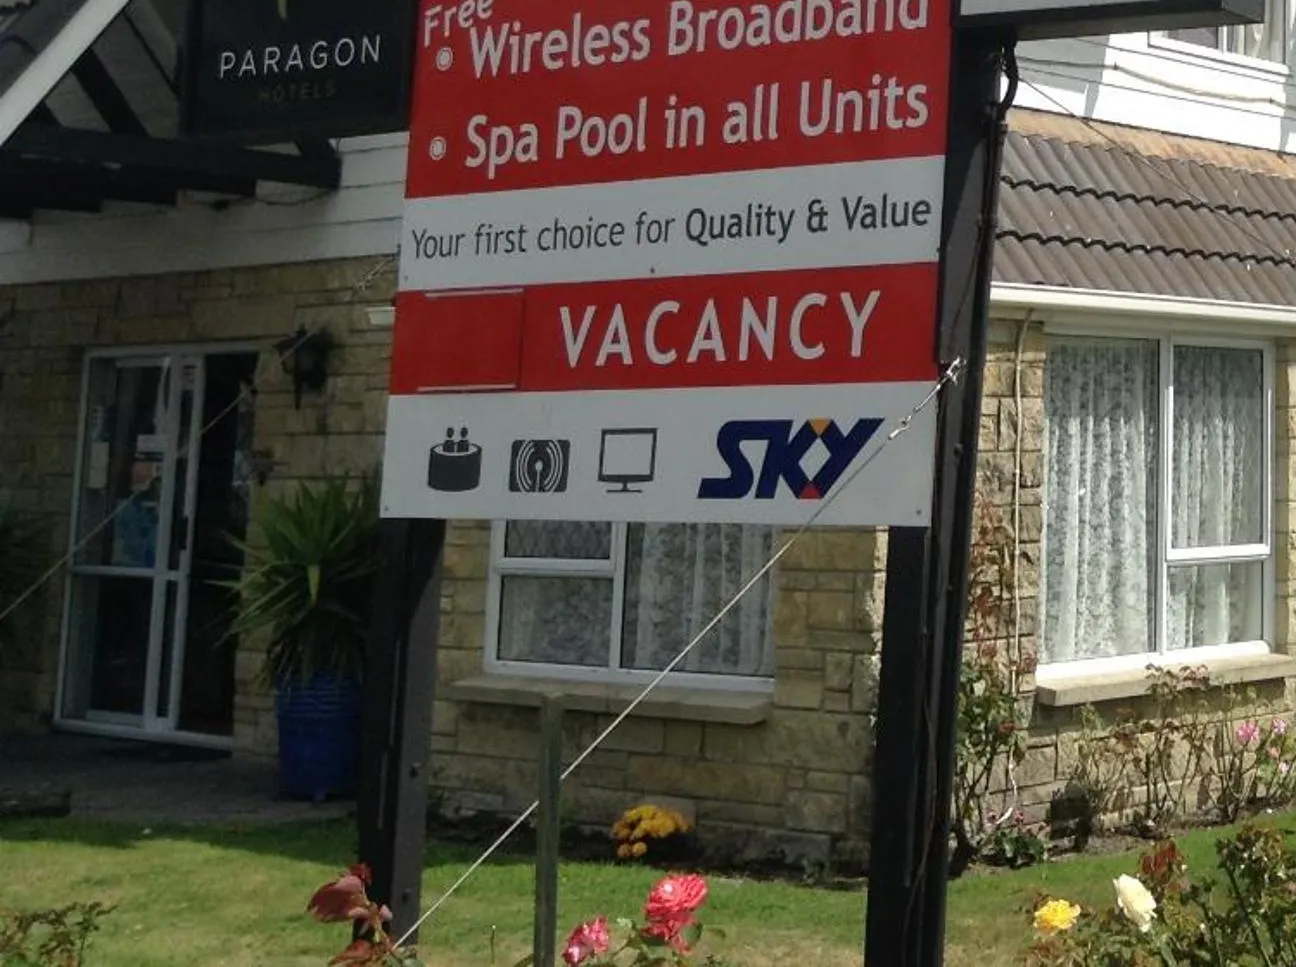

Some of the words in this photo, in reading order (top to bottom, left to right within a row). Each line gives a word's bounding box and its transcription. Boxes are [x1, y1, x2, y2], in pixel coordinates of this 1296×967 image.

[220, 35, 381, 79] PARAGON
[470, 12, 650, 79] Wireless
[465, 114, 538, 180] Spa
[556, 97, 647, 158] Pool
[665, 94, 704, 151] in
[725, 82, 779, 144] all
[800, 74, 928, 137] Units
[412, 229, 464, 258] Your
[475, 223, 526, 254] first
[538, 216, 625, 251] choice
[635, 212, 675, 244] for
[685, 203, 794, 244] Quality
[807, 198, 828, 233] &
[842, 193, 932, 230] Value
[559, 291, 881, 368] VACANCY
[697, 417, 885, 499] SKY
